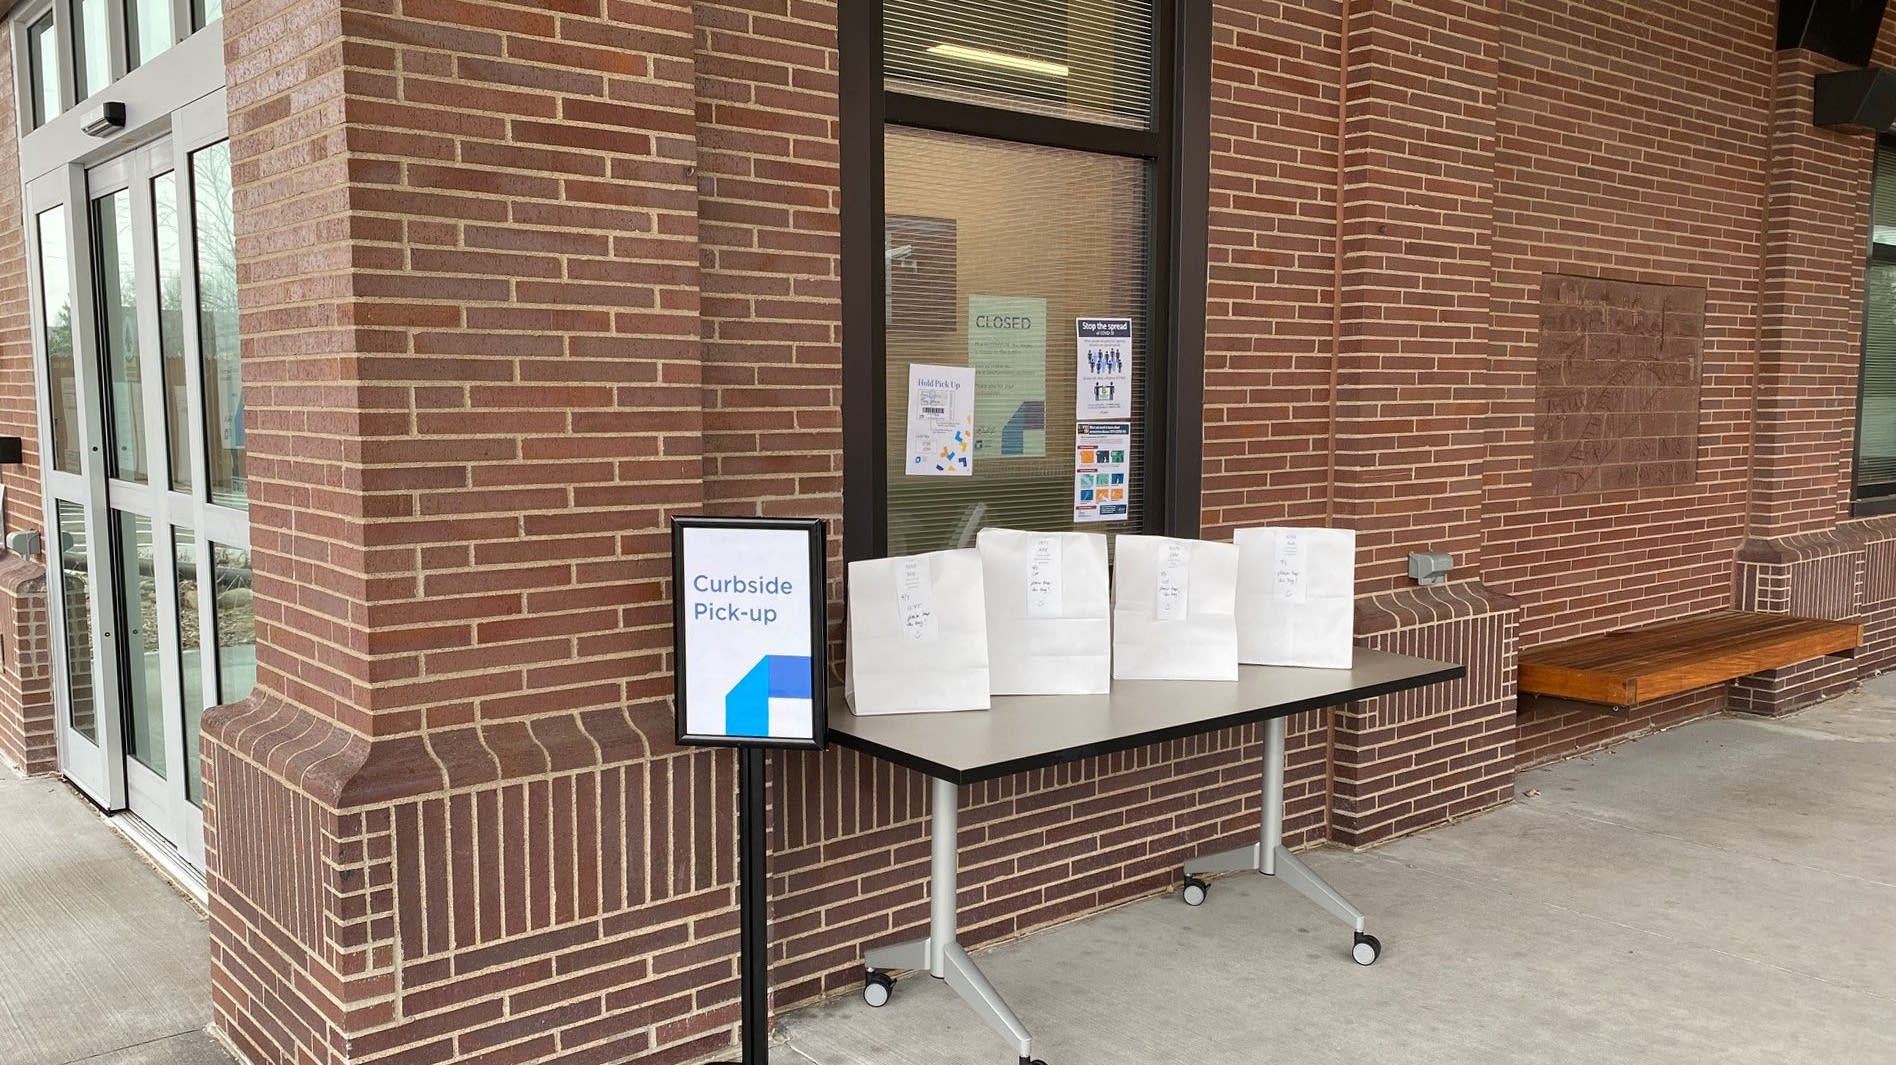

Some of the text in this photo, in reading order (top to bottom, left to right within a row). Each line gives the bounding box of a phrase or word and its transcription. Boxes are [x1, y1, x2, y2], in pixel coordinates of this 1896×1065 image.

[976, 315, 1031, 329] CLOSED
[1082, 321, 1127, 332] Stop the spread
[918, 378, 960, 389] Hold Pick Up
[693, 574, 793, 595] Curbside
[694, 603, 777, 625] Pick-up
